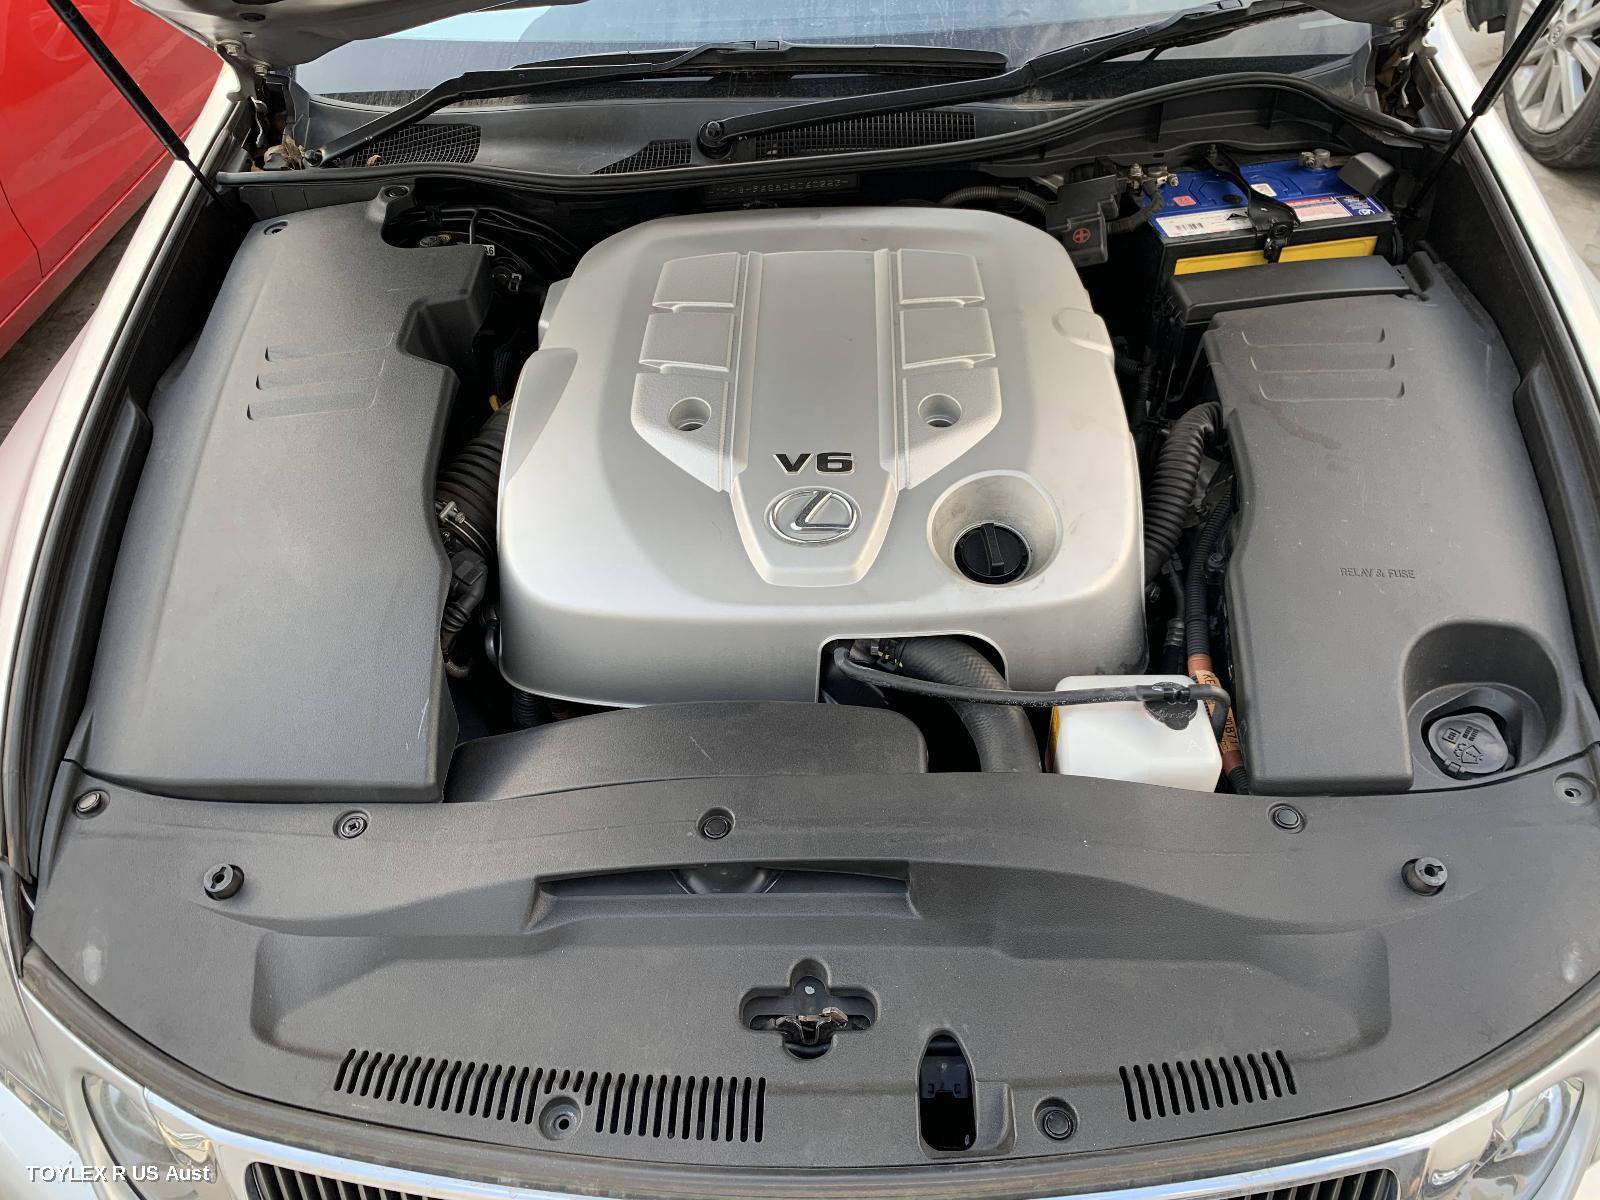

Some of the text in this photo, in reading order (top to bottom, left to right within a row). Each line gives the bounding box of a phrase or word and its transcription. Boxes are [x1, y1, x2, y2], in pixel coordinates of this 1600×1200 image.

[774, 453, 854, 475] V6
[1339, 567, 1416, 579] RELAY & FUSE
